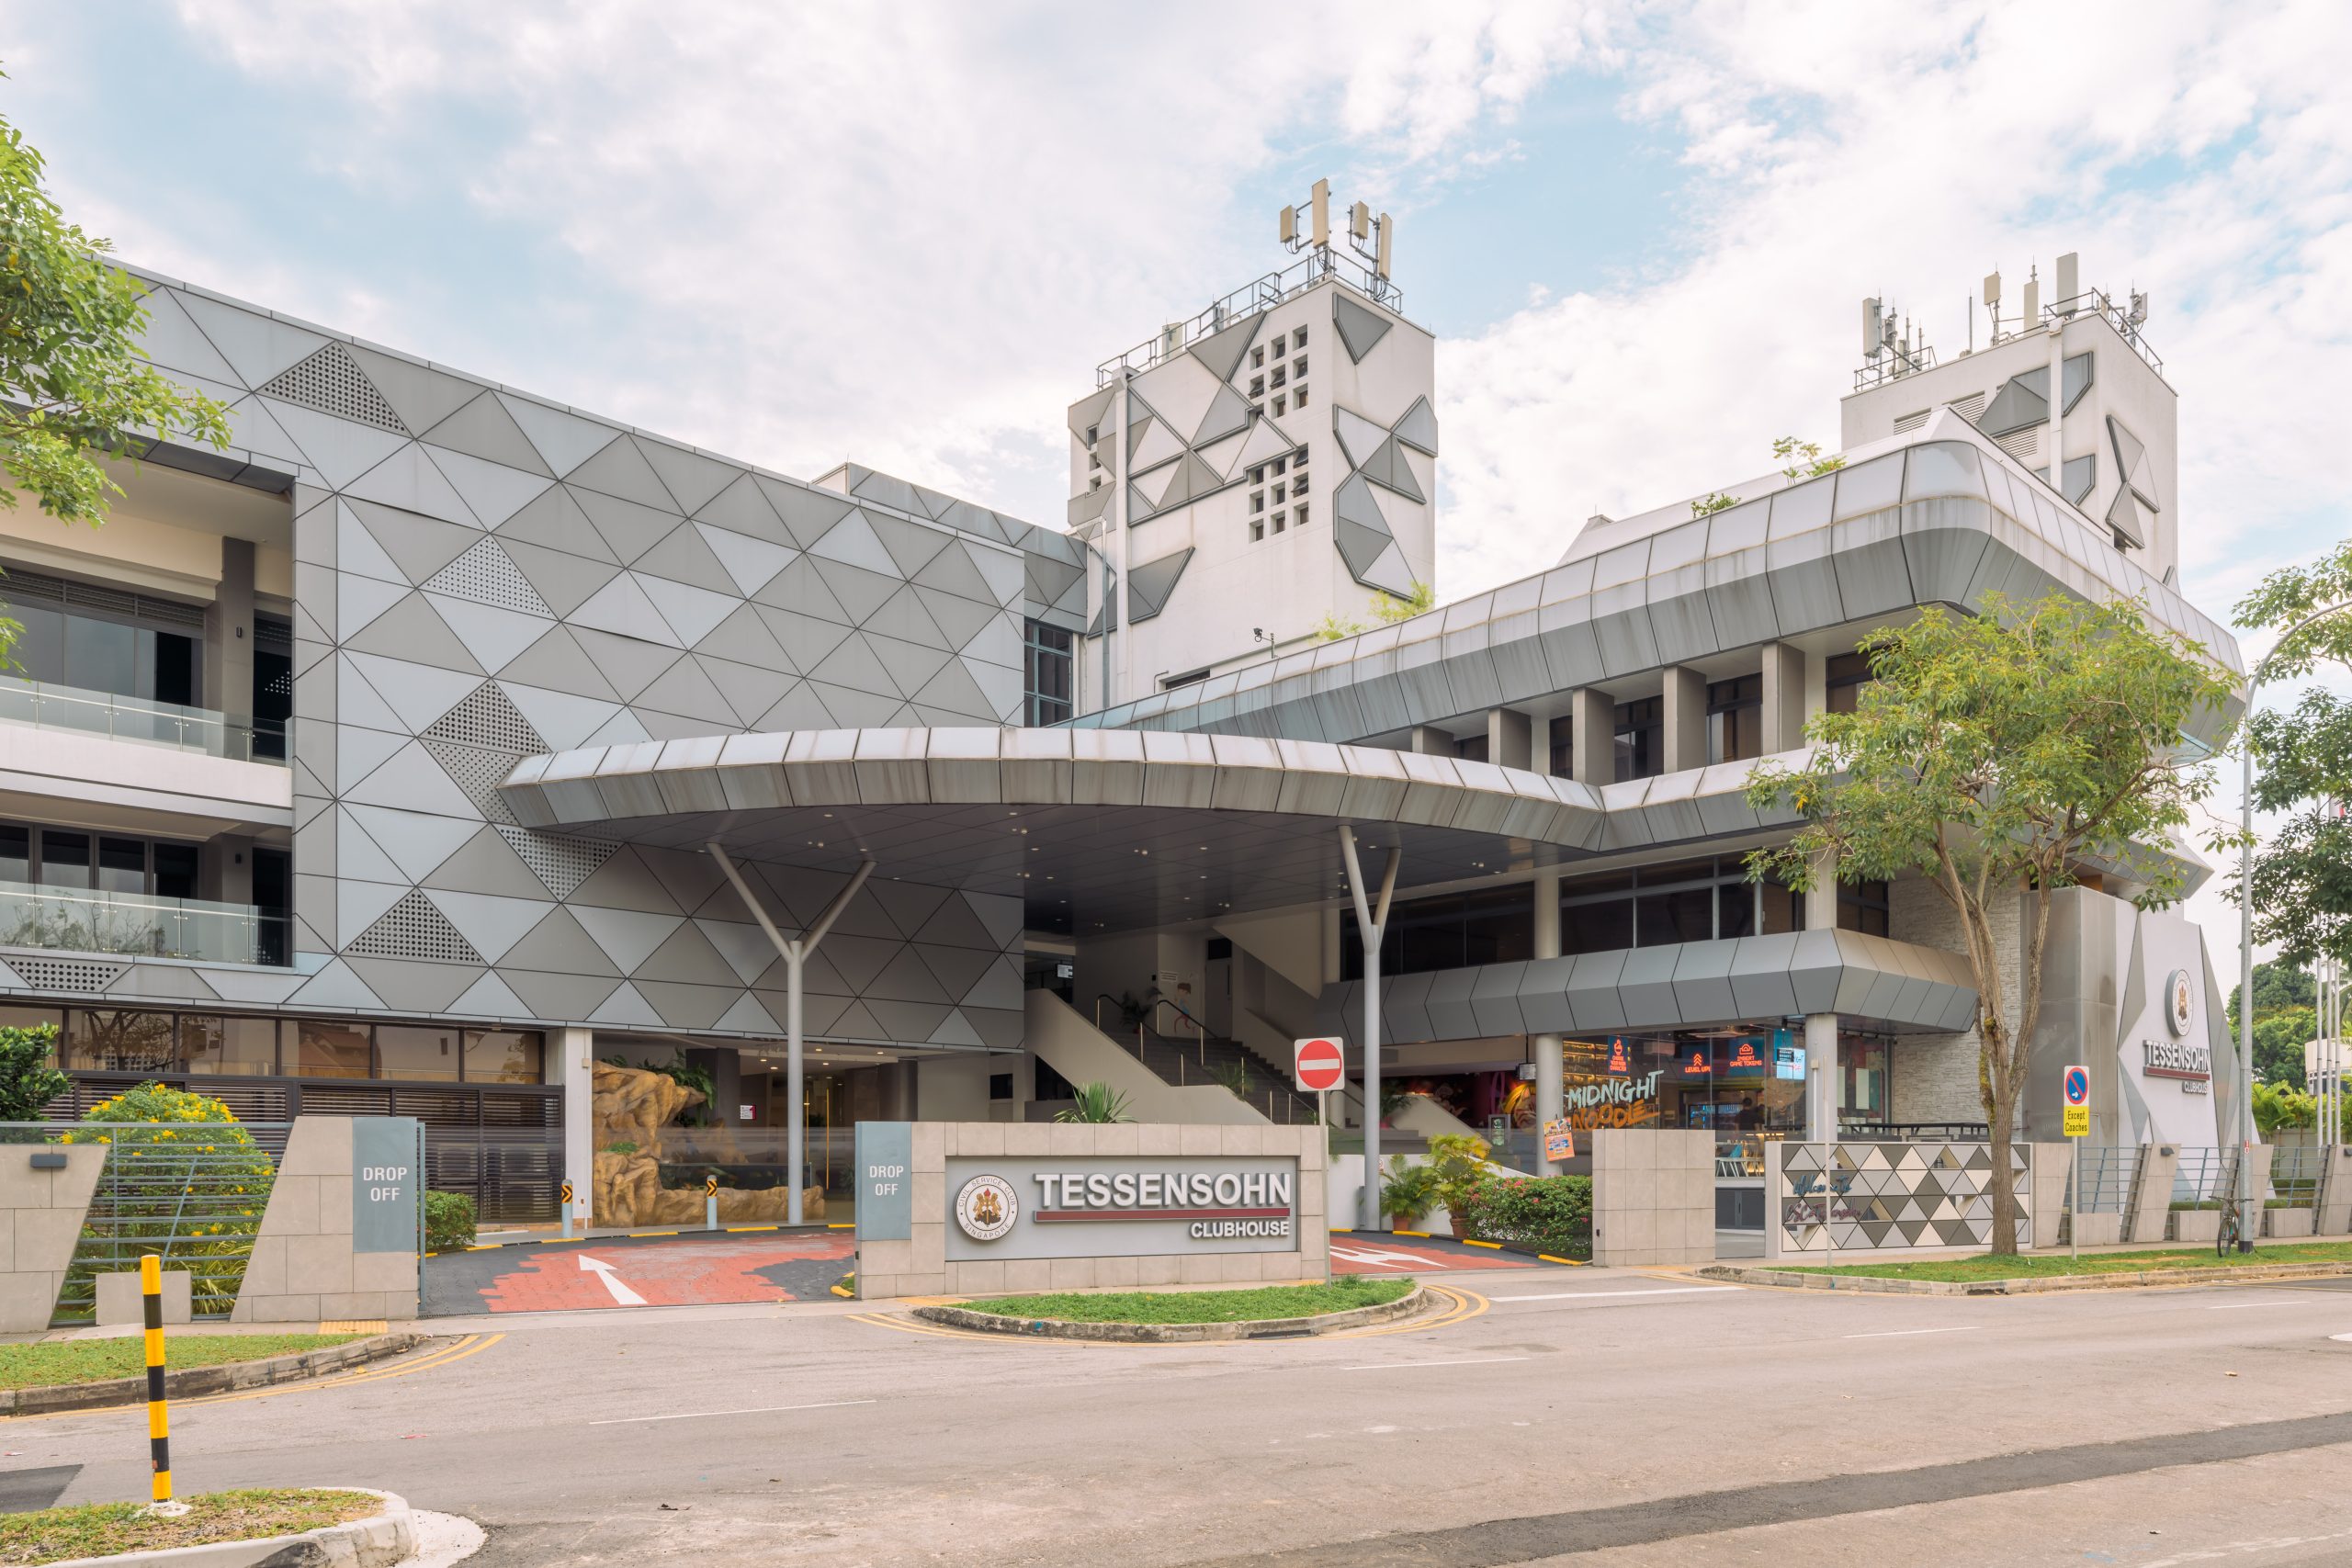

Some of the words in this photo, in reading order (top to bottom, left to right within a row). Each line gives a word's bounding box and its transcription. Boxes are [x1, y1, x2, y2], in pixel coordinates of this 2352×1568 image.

[2145, 1039, 2211, 1072] TESSENSOHN
[1567, 1070, 1665, 1111] MIDNIGHT
[2183, 1081, 2209, 1095] CLUBHOUS
[1572, 1099, 1661, 1132] NOODLE
[2067, 1111, 2086, 1122] Except
[2064, 1122, 2087, 1132] Coaches
[363, 1167, 408, 1181] DROP
[869, 1166, 904, 1178] DROP
[370, 1187, 401, 1201] OFF
[875, 1183, 899, 1196] OFF
[958, 1190, 970, 1207] CIVIL
[971, 1177, 1003, 1188] SERVICE
[1004, 1186, 1017, 1206] CLUB
[1035, 1173, 1291, 1207] TESSENSOHN
[964, 1222, 1011, 1239] SINGAPORE
[1190, 1221, 1290, 1238] CLUBHOUSE
